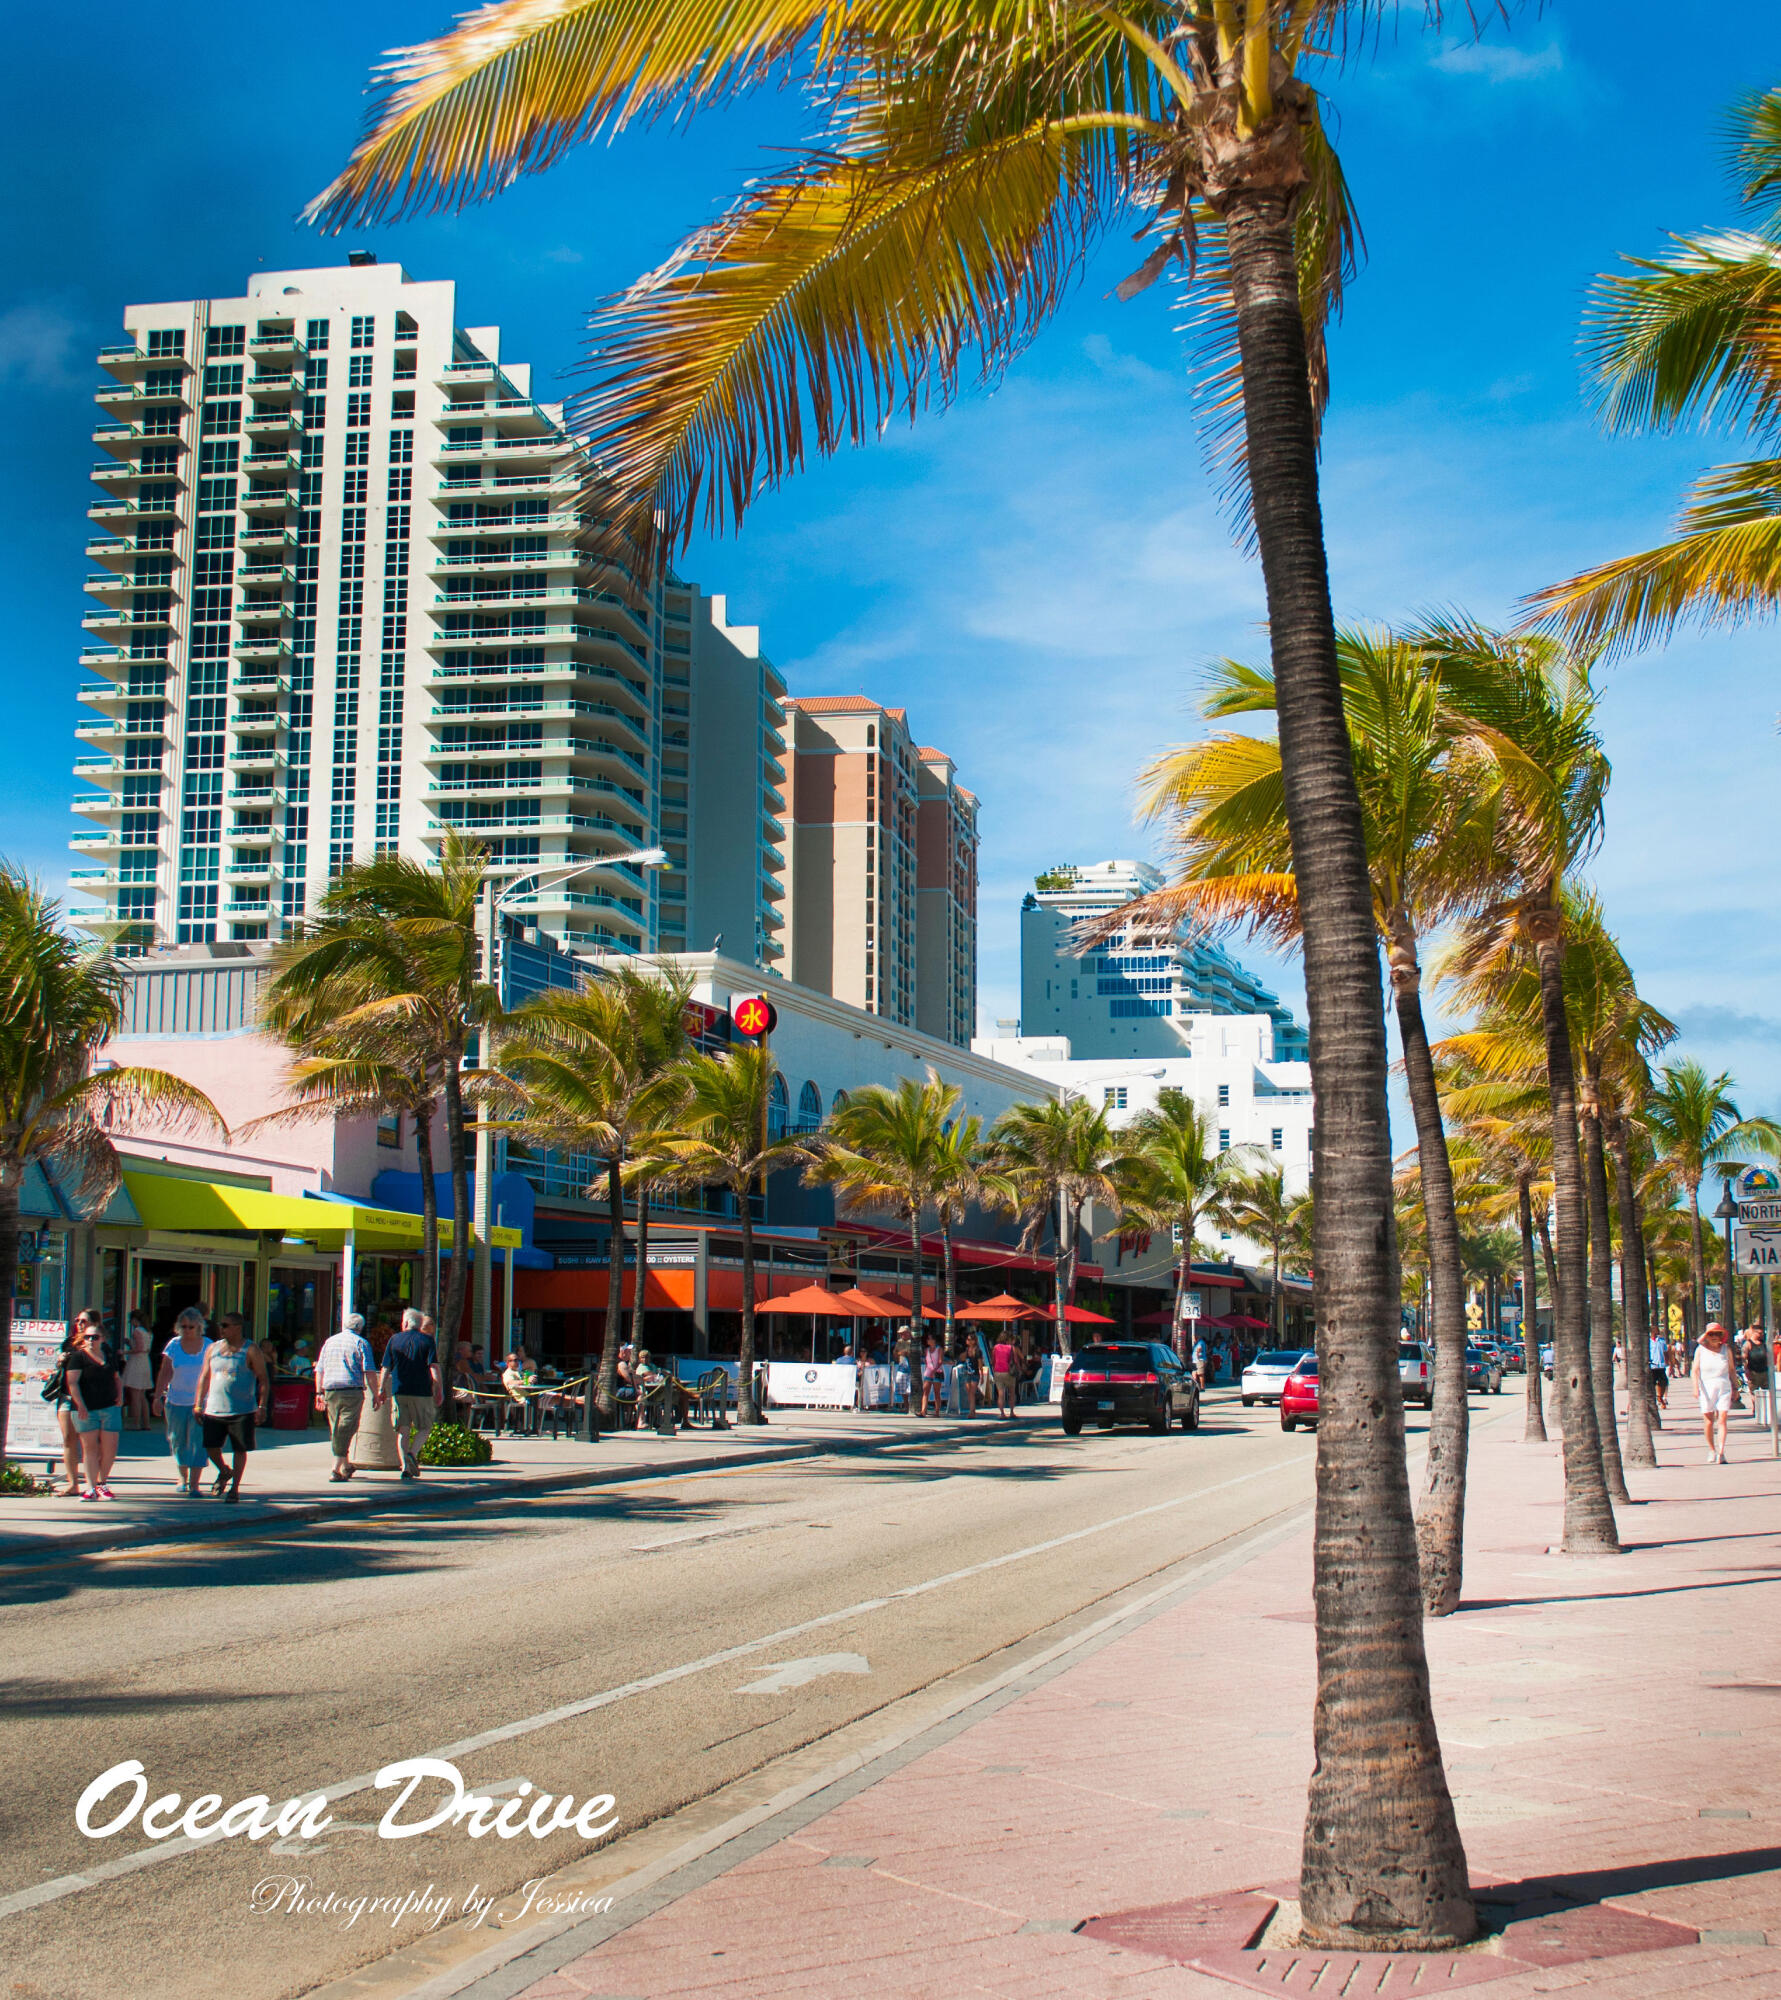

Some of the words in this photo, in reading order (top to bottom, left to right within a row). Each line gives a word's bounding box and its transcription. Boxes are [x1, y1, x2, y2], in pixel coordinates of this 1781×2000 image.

[740, 1002, 764, 1031] 水
[1740, 1204, 1781, 1219] NORTH
[663, 1256, 695, 1264] OYSTERS
[1707, 1299, 1721, 1310] 30
[28, 1320, 66, 1332] PIZZA
